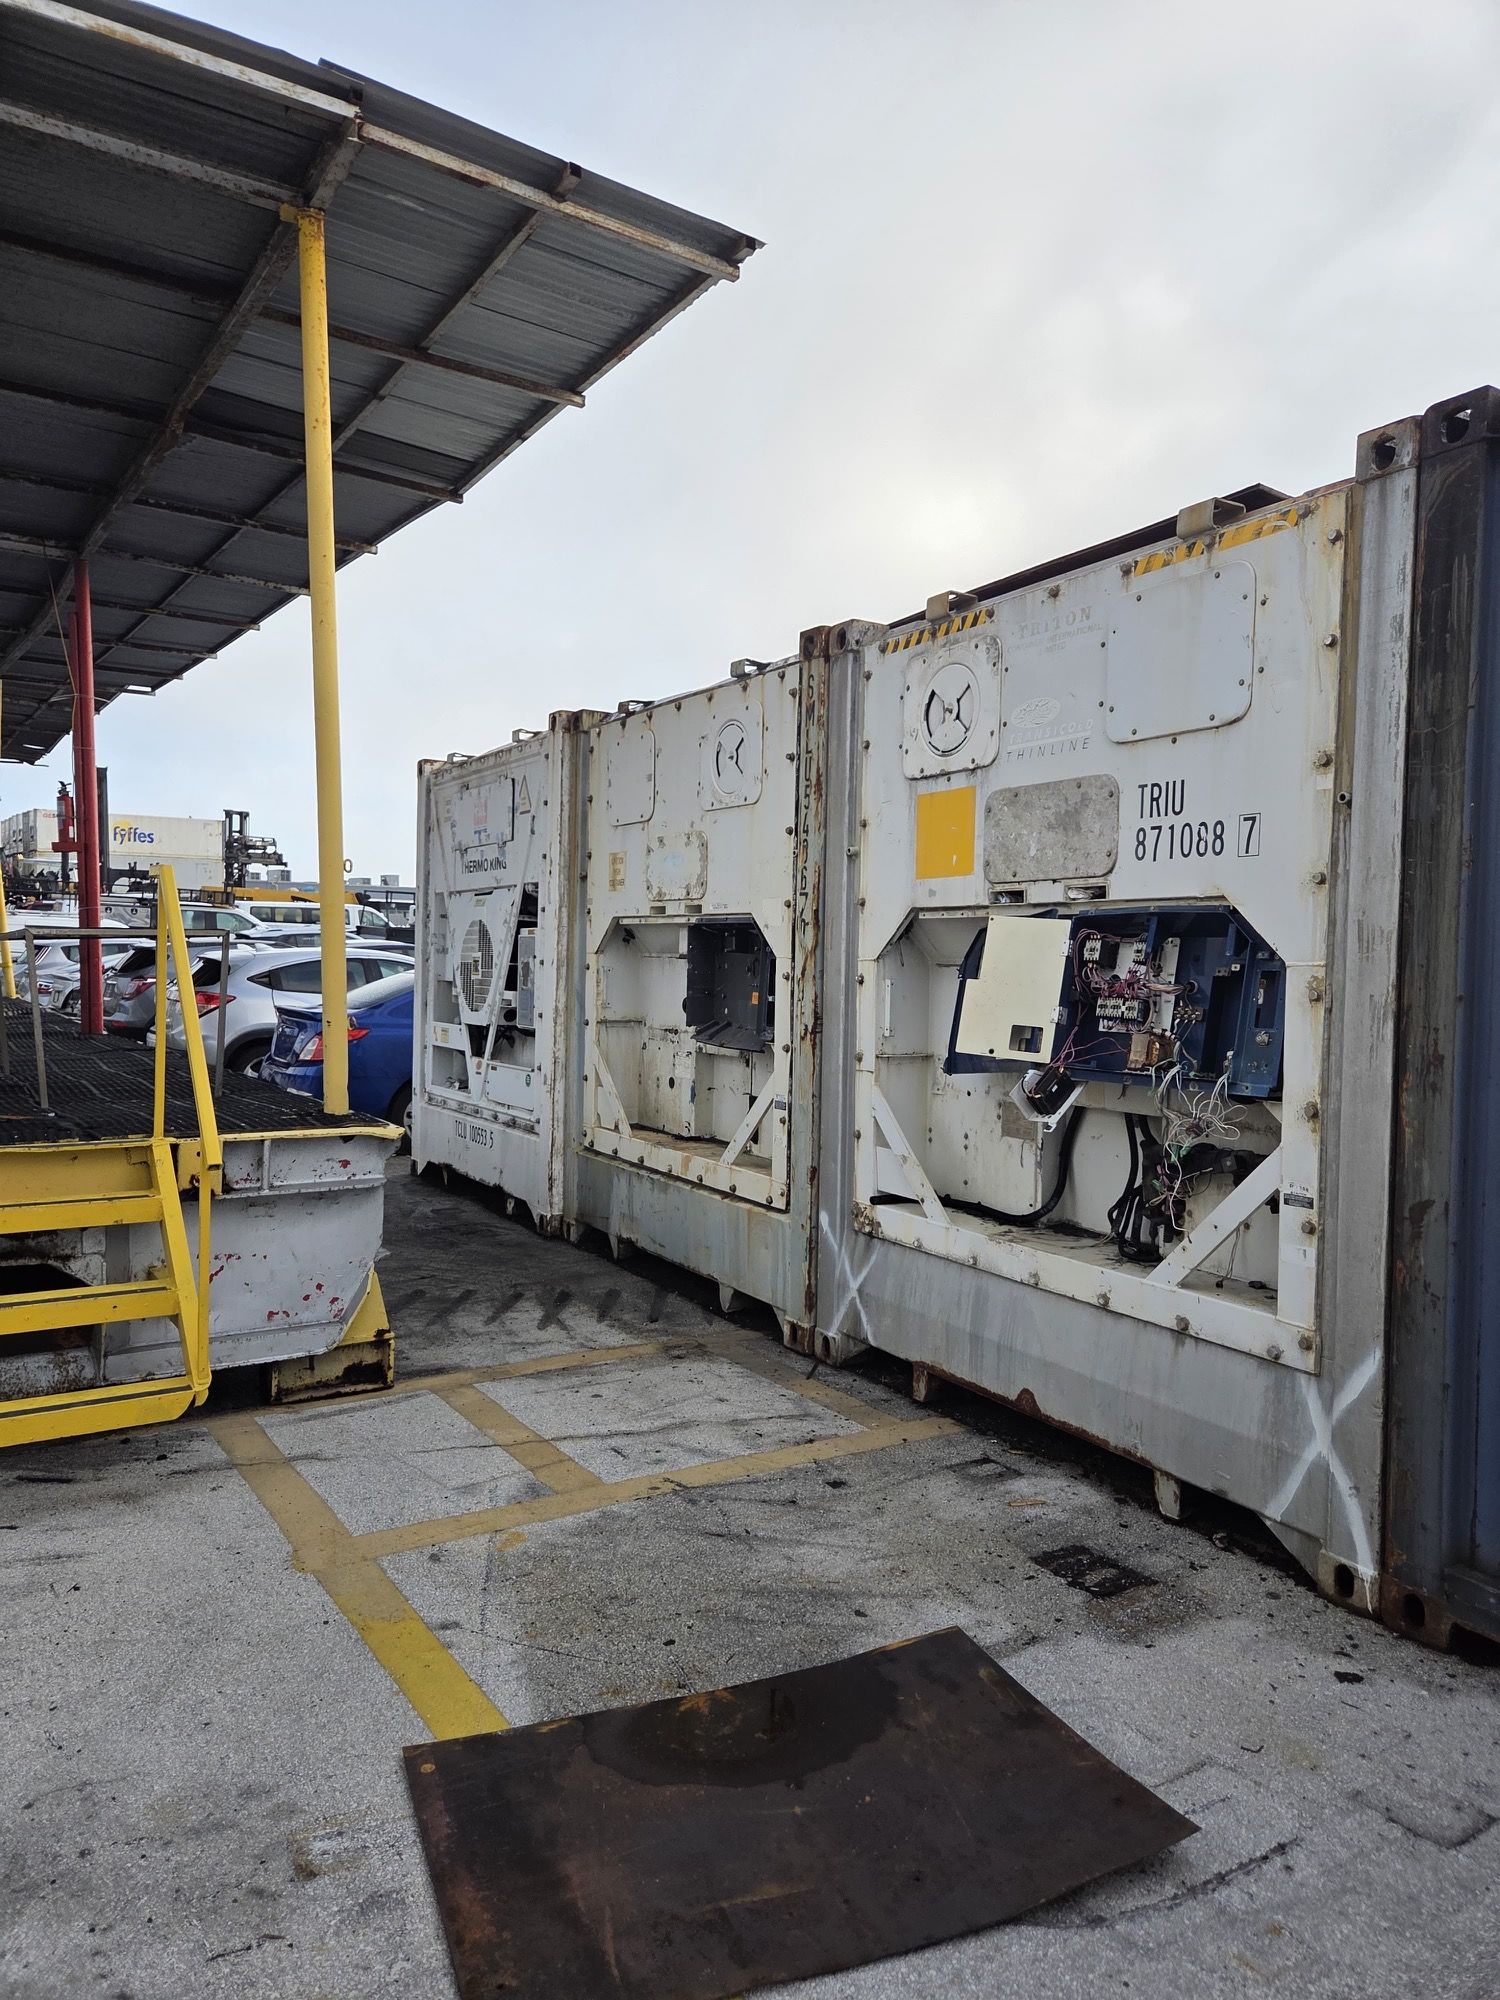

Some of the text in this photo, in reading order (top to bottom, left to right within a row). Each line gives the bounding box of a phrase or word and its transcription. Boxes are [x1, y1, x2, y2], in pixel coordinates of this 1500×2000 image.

[1006, 737, 1090, 762] THINLINE
[1137, 779, 1185, 819] TRIU
[113, 826, 155, 845] fyffes
[1134, 815, 1258, 862] 871088 7
[461, 856, 507, 874] THERMO KING
[489, 1131, 494, 1149] 5
